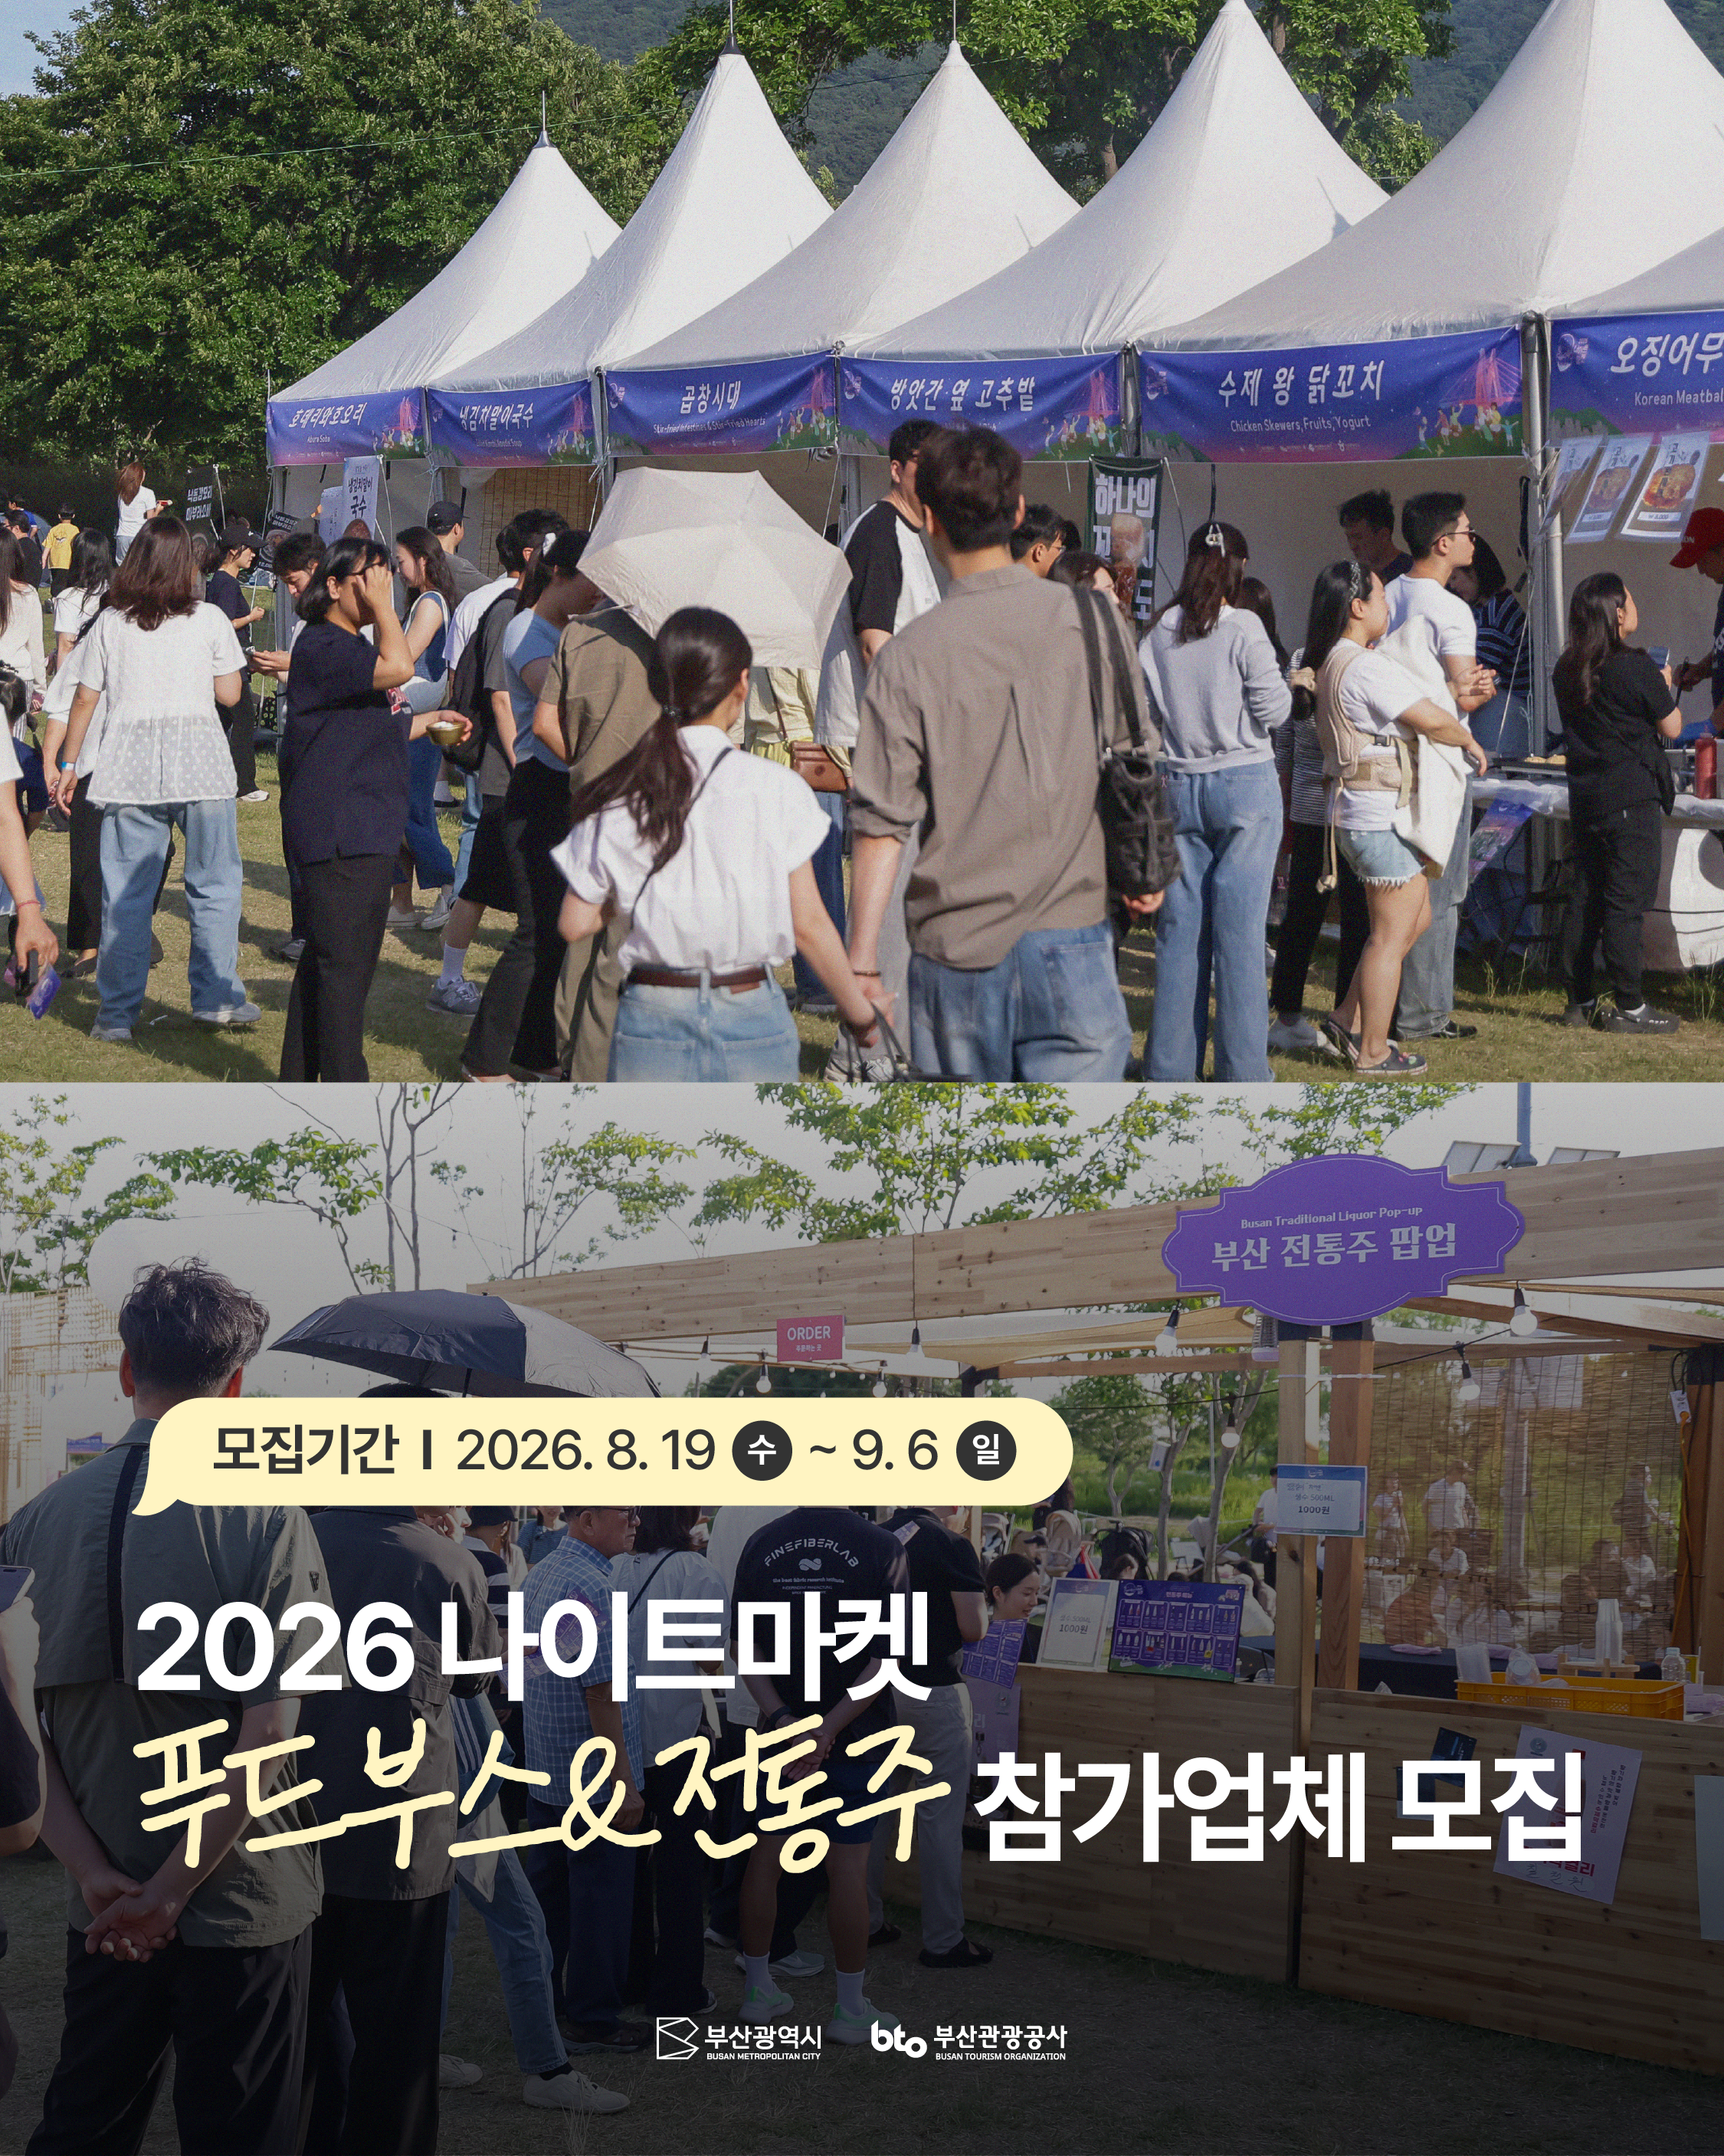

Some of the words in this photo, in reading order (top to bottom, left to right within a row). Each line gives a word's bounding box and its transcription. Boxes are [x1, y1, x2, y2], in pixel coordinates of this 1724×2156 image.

[891, 378, 943, 411] 방앗간
[950, 378, 971, 411] 옆
[975, 376, 1034, 412] 고추밭
[1218, 368, 1262, 407] 수제
[1273, 366, 1294, 405] 왕
[1308, 360, 1384, 404] 닭꼬치
[680, 380, 741, 414] 곱창시대
[1635, 392, 1673, 405] Korean
[460, 402, 533, 432] 냉김치말이국수
[654, 424, 680, 433] Stir-fried
[712, 418, 744, 430] Stir-fried
[744, 416, 765, 427] Hearts
[1231, 420, 1264, 432] Chicken
[1336, 415, 1371, 431] Yogurt
[349, 477, 373, 493] 냉김치말이
[1095, 474, 1157, 518] 하나의
[351, 495, 367, 518] 국수
[1241, 1218, 1273, 1229] Busan
[1275, 1212, 1336, 1227] Traditional
[1339, 1210, 1377, 1222] Liquor
[1378, 1206, 1423, 1219] Pop-up
[1212, 1236, 1270, 1272] 부산
[1280, 1230, 1378, 1268] 전통주
[1390, 1222, 1457, 1261] 팝업
[787, 1325, 831, 1341] ORDER
[1299, 1506, 1329, 1514] 1000원
[764, 1538, 859, 1567] FINEFIBERLAB
[1060, 1624, 1088, 1634] 1000원
